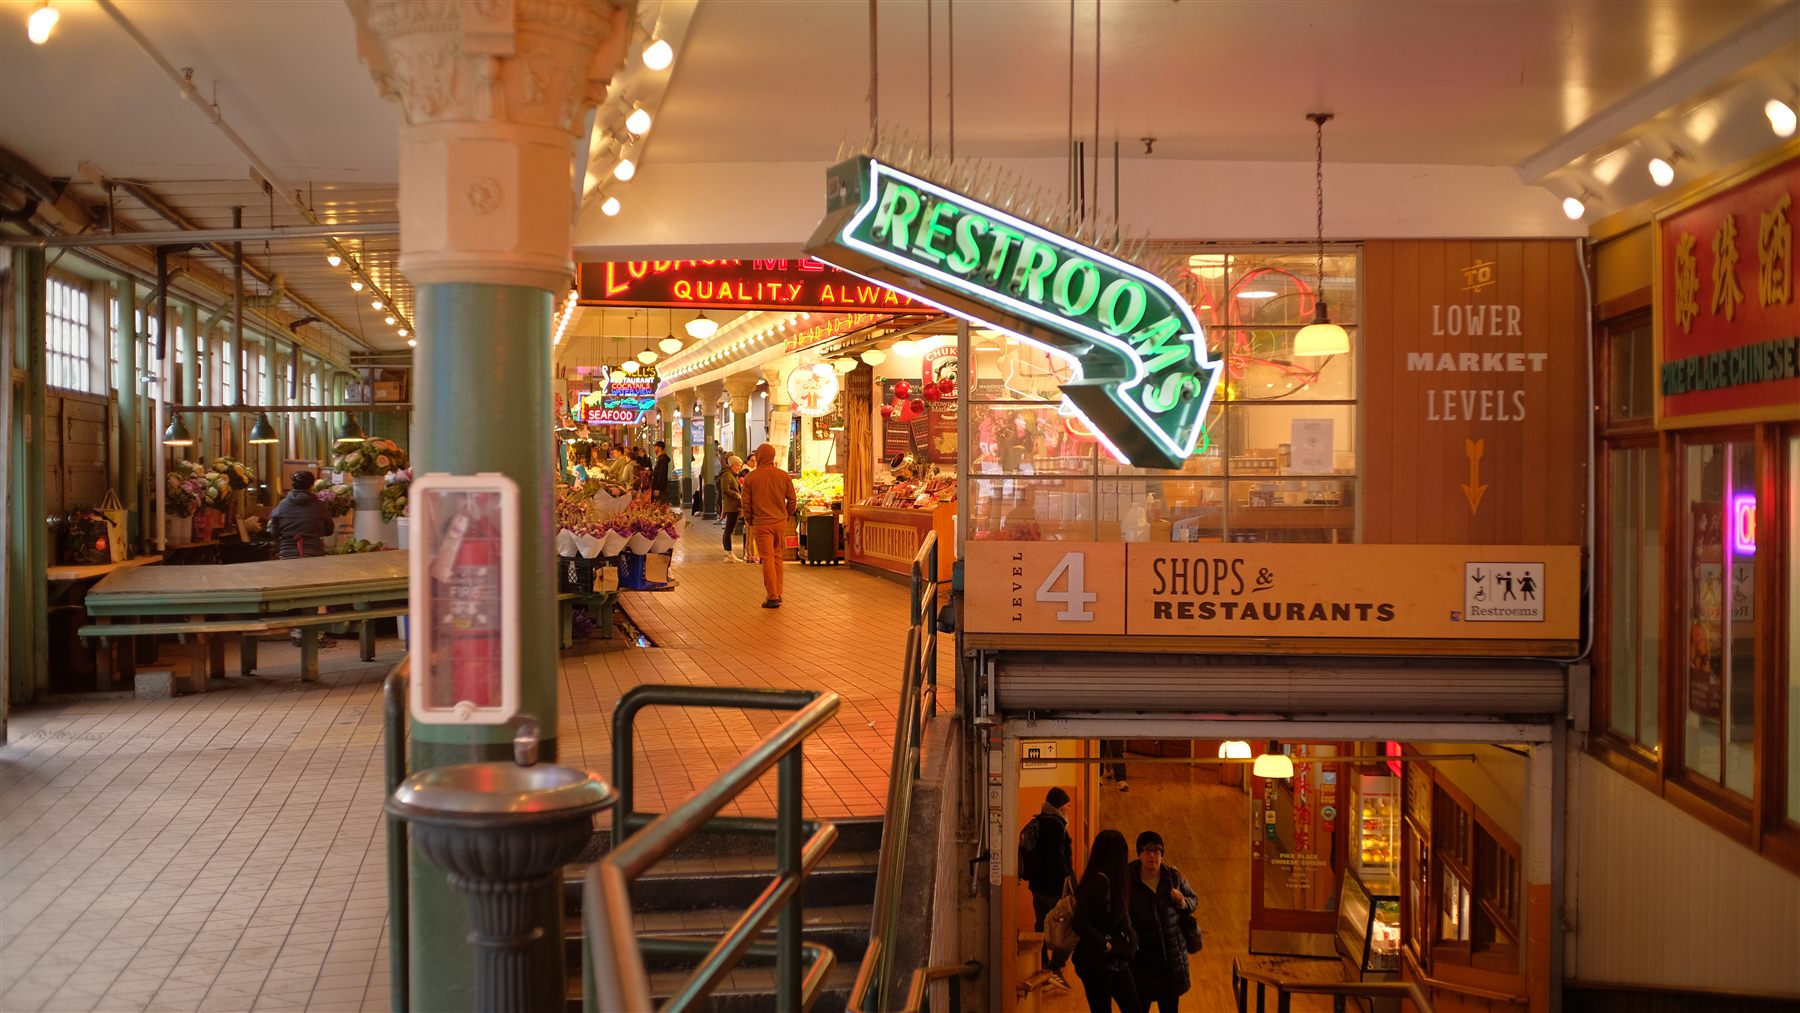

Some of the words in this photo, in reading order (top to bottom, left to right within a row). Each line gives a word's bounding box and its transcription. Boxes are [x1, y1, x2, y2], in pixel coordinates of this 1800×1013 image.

[1463, 266, 1491, 285] TO
[674, 280, 802, 301] QUALITY
[821, 283, 912, 305] ALWA
[872, 182, 1201, 413] RESTROOMS
[1432, 304, 1522, 336] LOWER
[925, 346, 958, 361] CHUK
[1407, 352, 1548, 372] MARKET
[1687, 350, 1730, 392] PLACE
[1729, 336, 1796, 387] CHINESE
[588, 410, 633, 420] SEAFOOD
[1427, 390, 1526, 421] LEVELS
[1012, 552, 1022, 622] LEVEL
[1036, 552, 1096, 621] 4
[1153, 558, 1244, 595] SHOPS
[1254, 567, 1274, 590] &
[1154, 601, 1395, 622] RESTAURANTS
